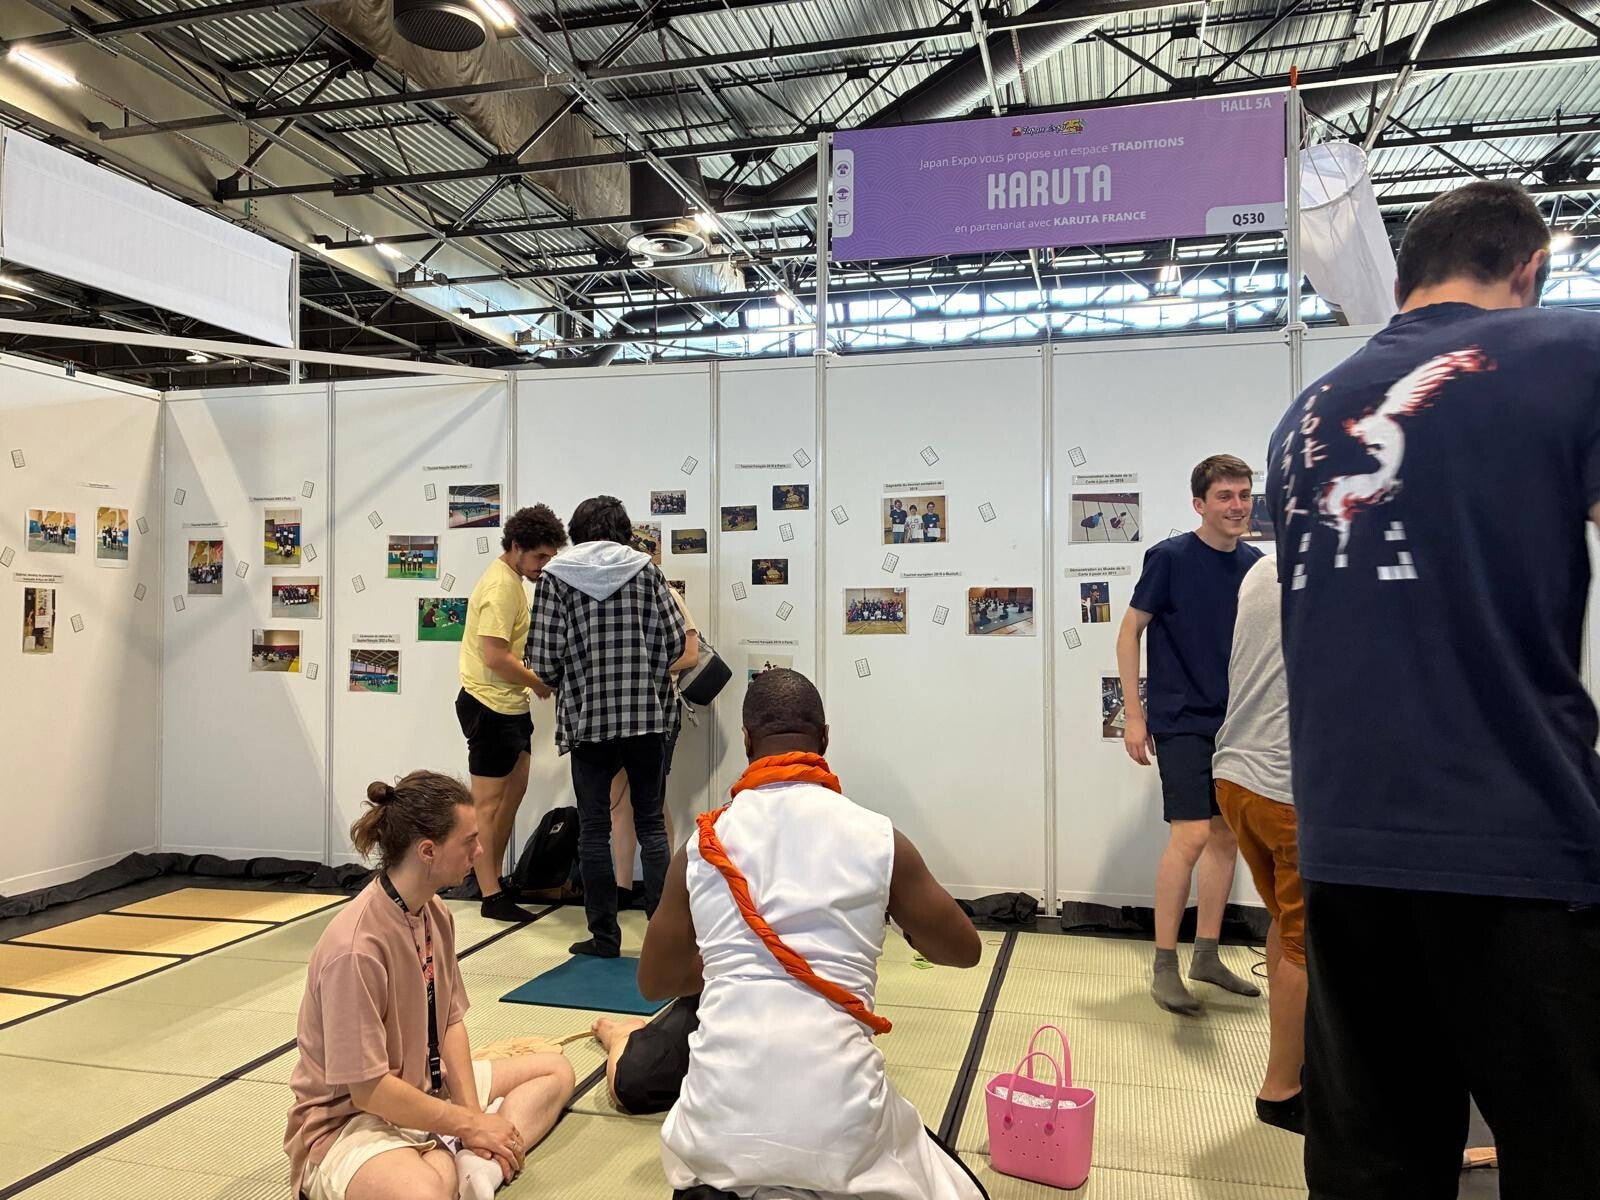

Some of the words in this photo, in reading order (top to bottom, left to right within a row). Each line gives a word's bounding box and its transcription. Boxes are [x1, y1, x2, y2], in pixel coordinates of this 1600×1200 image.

[1221, 99, 1252, 112] HALL
[1255, 97, 1271, 109] 5A
[919, 158, 949, 170] Japan
[951, 155, 977, 167] Expo
[979, 153, 1004, 163] vous
[1007, 150, 1051, 165] propose
[1054, 148, 1068, 157] un
[1070, 144, 1109, 158] espace
[1110, 136, 1185, 152] TRADITIONS
[987, 164, 1112, 210] KARUTA
[954, 225, 967, 233] en
[969, 220, 1025, 234] partenariat
[1028, 219, 1052, 228] avec
[1053, 214, 1099, 227] KARUTA
[1102, 211, 1147, 223] FRANCE
[1232, 212, 1265, 226] Q530
